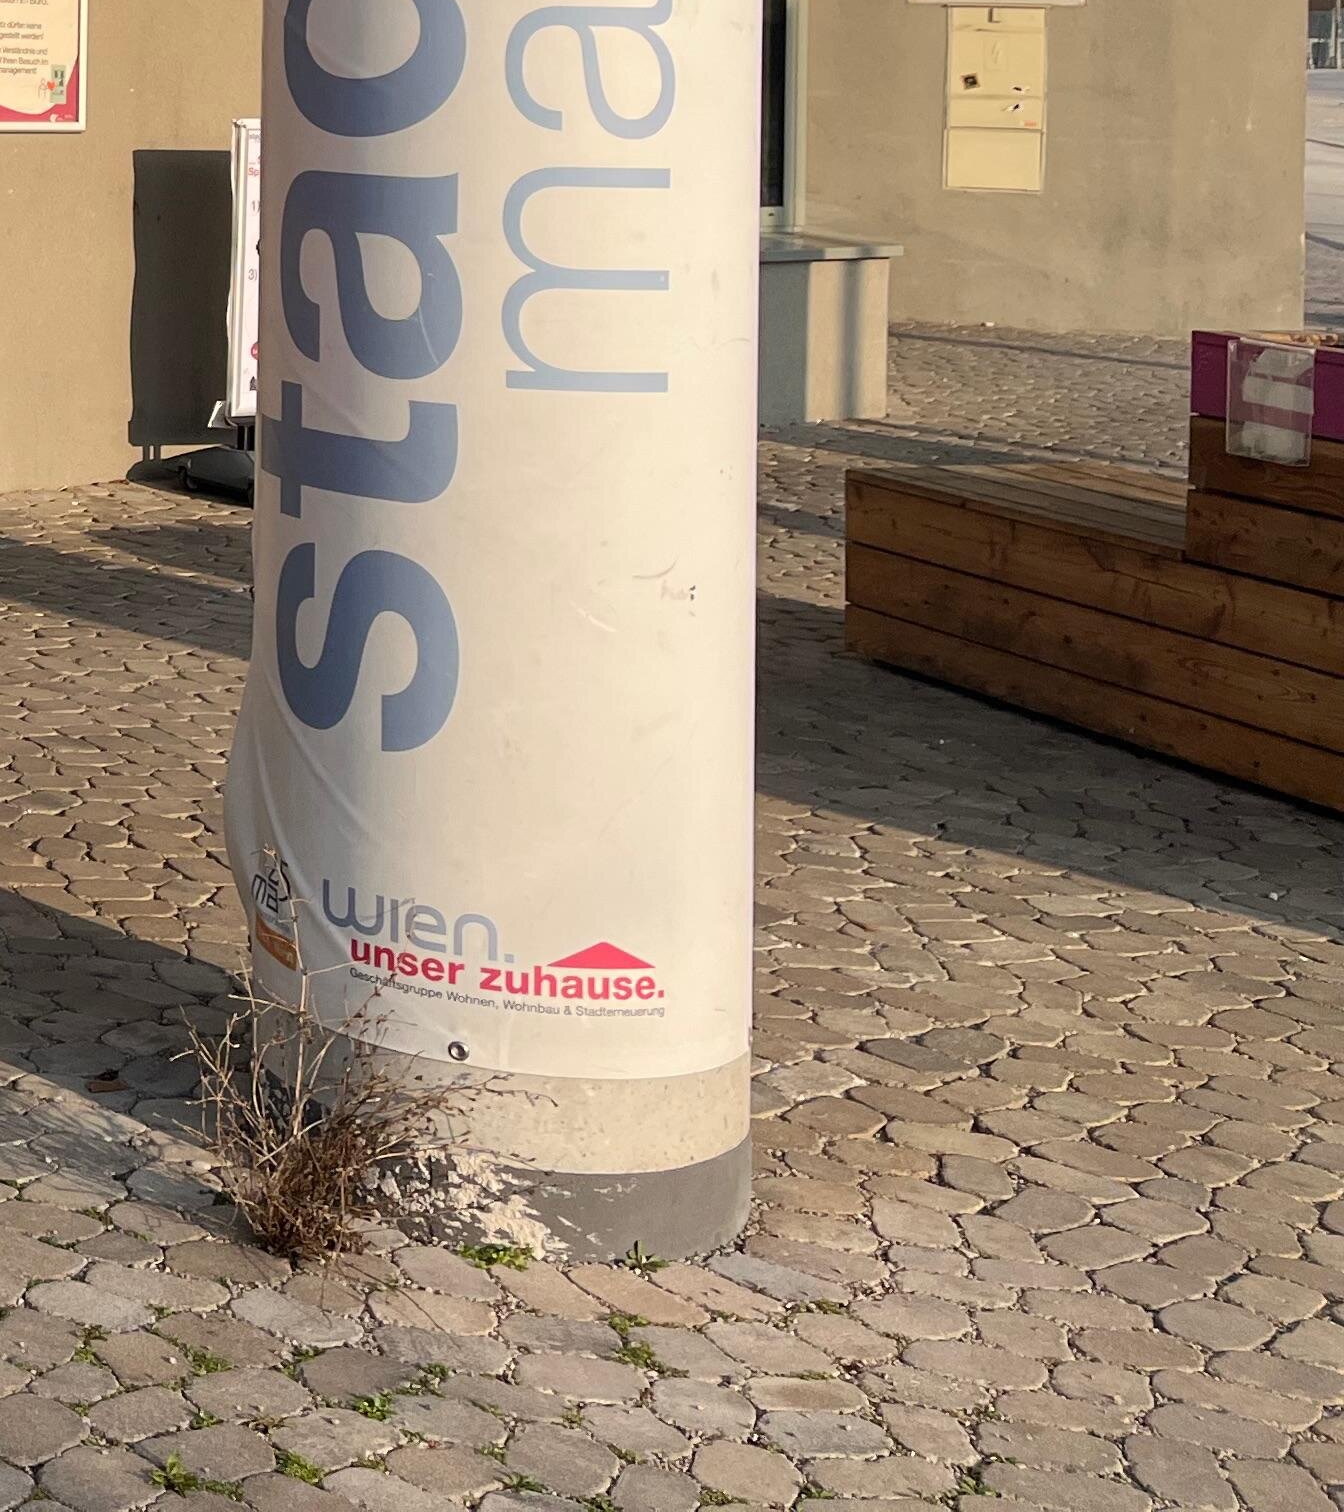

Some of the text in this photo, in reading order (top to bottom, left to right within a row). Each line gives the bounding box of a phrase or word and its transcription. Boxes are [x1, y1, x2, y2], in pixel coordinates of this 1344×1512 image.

[349, 967, 443, 999] Geschäftsgruppe
[447, 990, 499, 1010] Wohnen,
[503, 999, 560, 1015] Wohnbau
[575, 1005, 665, 1018] Stadterneuerung
[351, 938, 665, 1000] unser zuhause.
